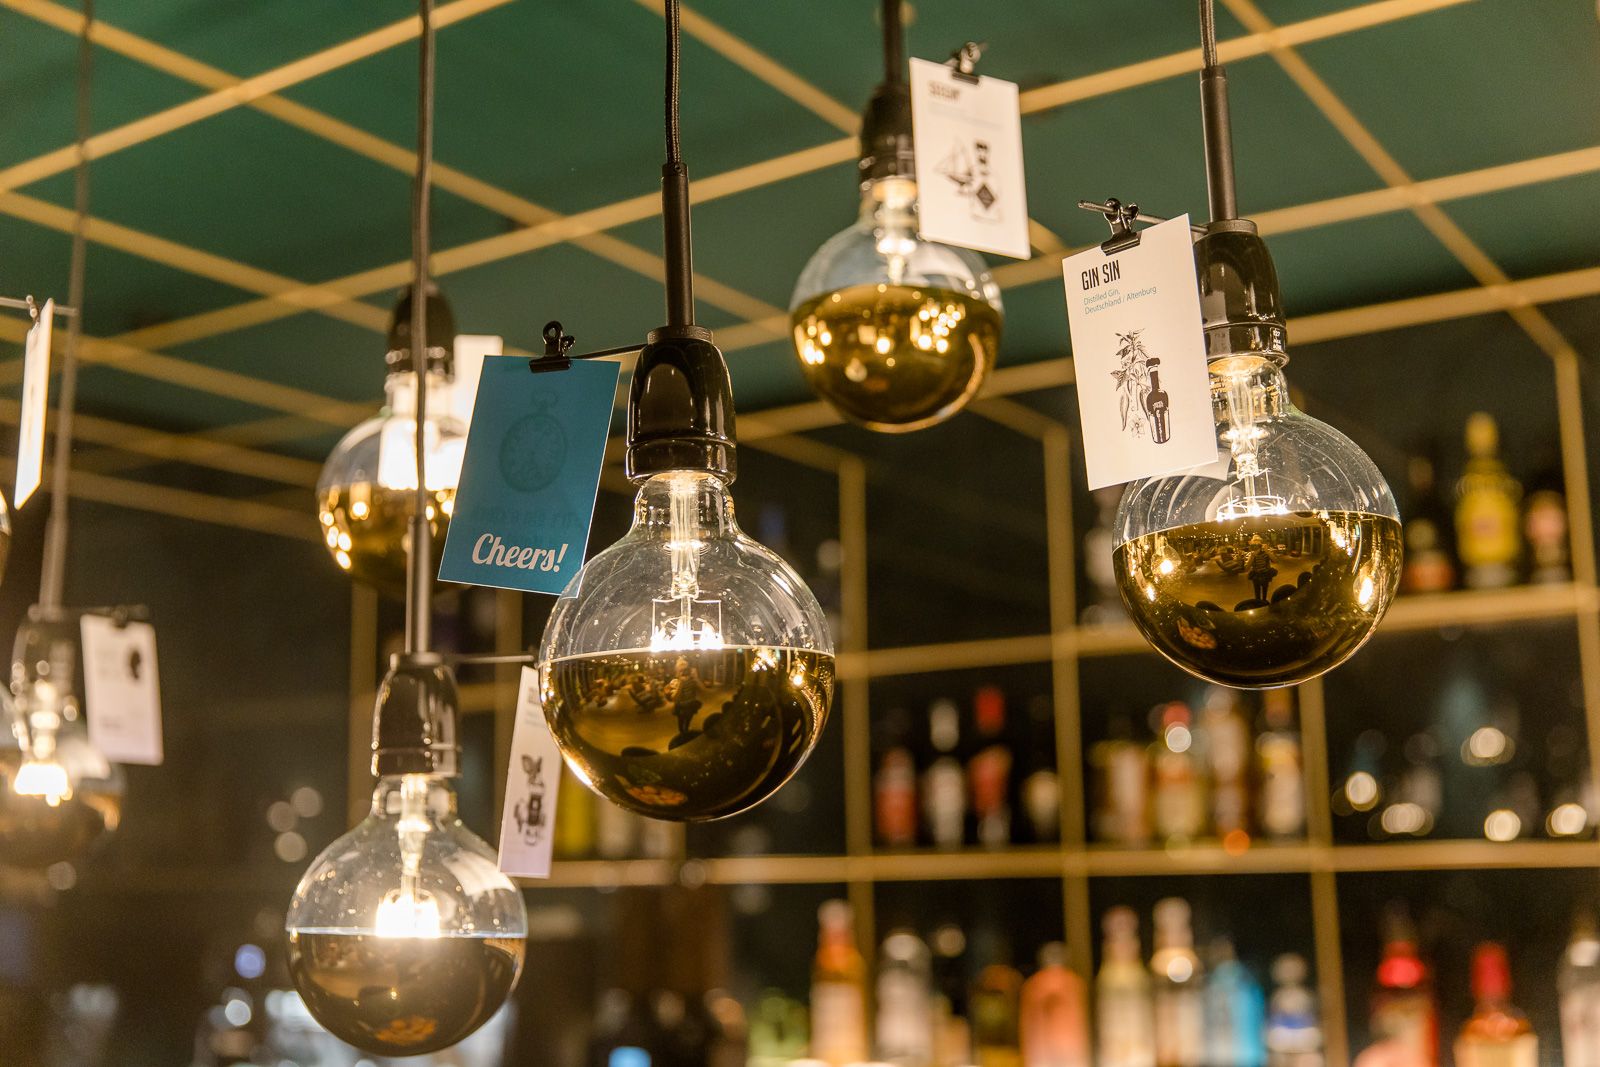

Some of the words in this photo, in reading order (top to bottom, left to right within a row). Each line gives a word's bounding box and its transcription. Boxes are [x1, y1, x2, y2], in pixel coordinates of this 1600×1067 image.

[1081, 266, 1100, 291] GIN
[1102, 259, 1121, 284] SIN
[1083, 291, 1107, 306] Distilled
[1084, 296, 1122, 315] Deutschland
[1126, 286, 1157, 302] Altenburg
[472, 533, 569, 573] Cheers!
